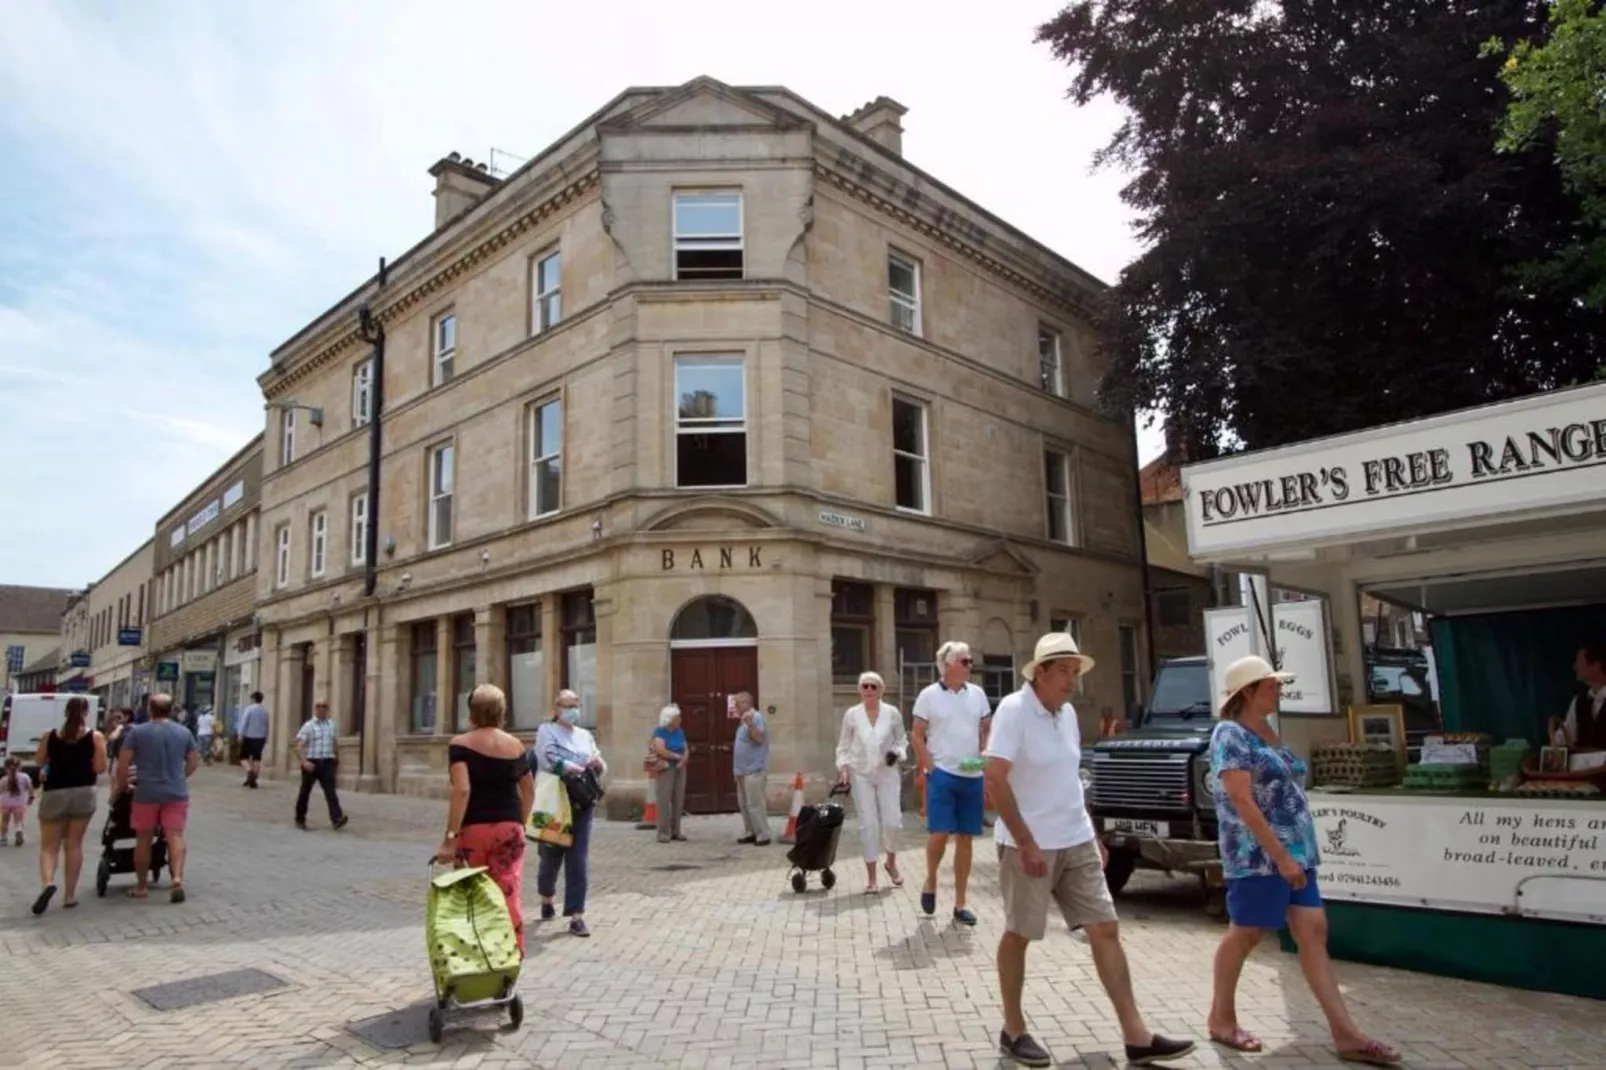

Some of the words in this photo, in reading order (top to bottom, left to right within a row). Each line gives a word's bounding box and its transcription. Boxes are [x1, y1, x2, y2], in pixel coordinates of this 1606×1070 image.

[1200, 467, 1350, 521] FOWLER'S
[1364, 448, 1453, 495] FREE
[661, 546, 762, 571] BANK
[1217, 623, 1249, 647] FOWL
[1279, 620, 1314, 640] EGGS
[1280, 691, 1303, 701] NGE
[1312, 808, 1337, 818] LER'S
[1340, 808, 1388, 829] POULTRY
[1459, 811, 1485, 825] All
[1496, 815, 1522, 829] my
[1533, 814, 1576, 829] hens
[1479, 834, 1500, 845] on
[1511, 832, 1597, 851] beautiful
[1318, 872, 1334, 882] ord
